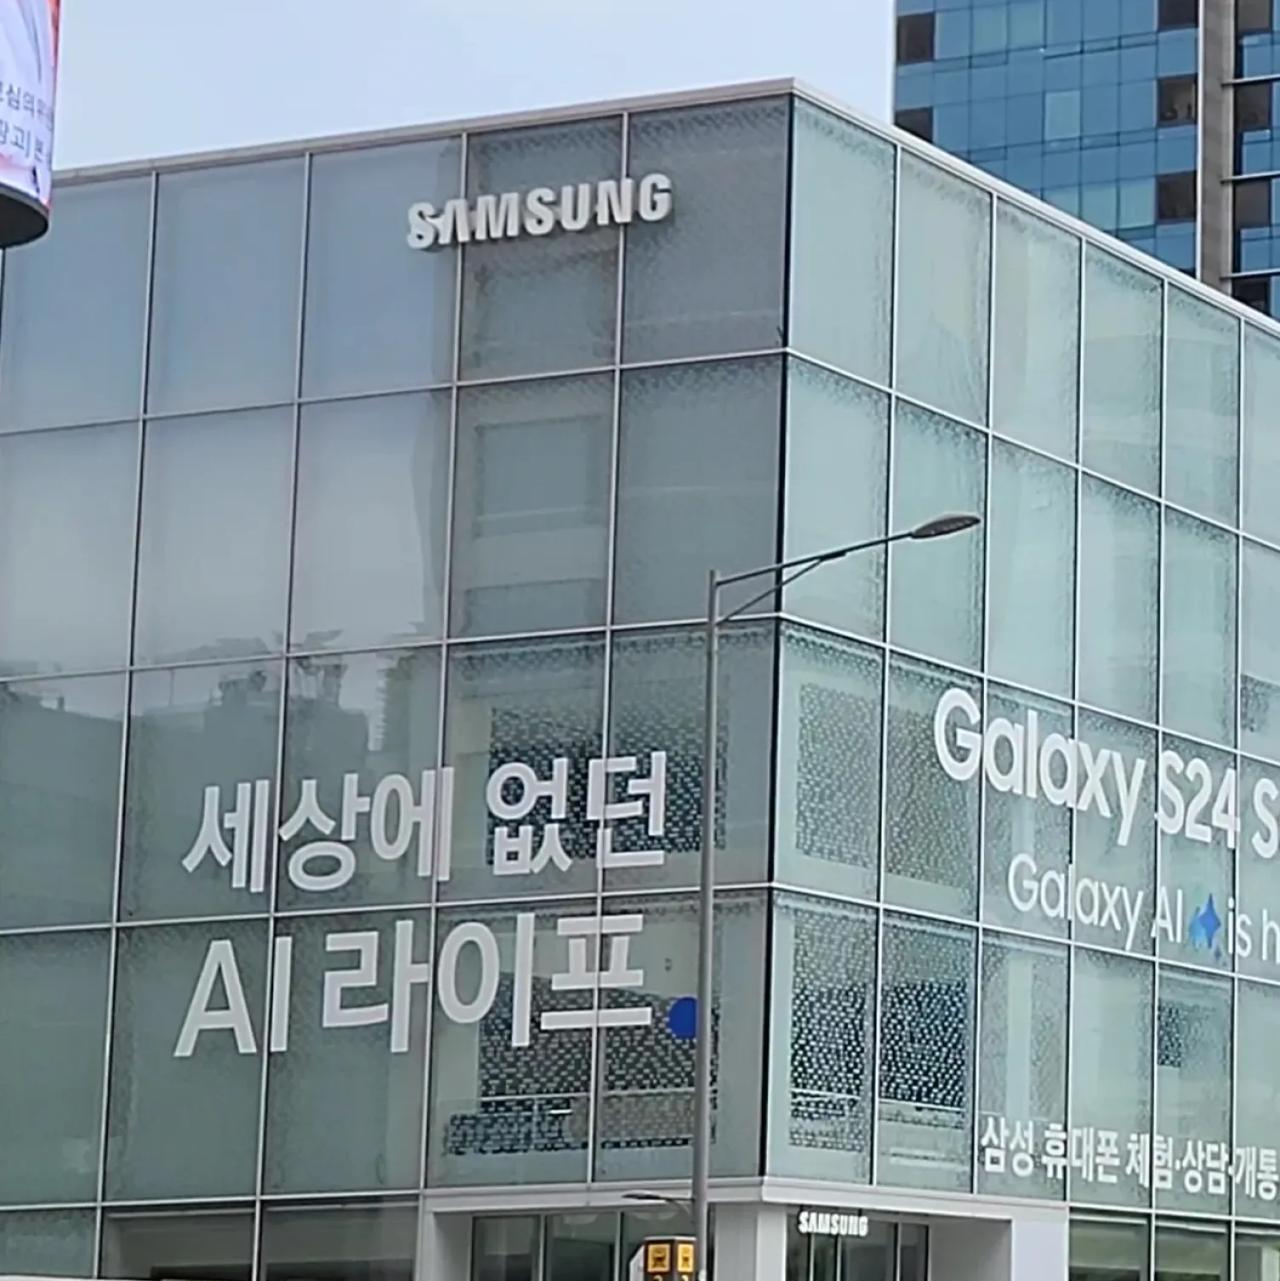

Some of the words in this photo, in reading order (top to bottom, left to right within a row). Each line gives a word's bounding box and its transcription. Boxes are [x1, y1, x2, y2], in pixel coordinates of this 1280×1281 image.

[406, 173, 673, 250] SAMSUNG
[934, 687, 1147, 847] Galaxy
[1156, 749, 1240, 850] S24
[181, 766, 455, 894] 세상에
[486, 751, 667, 876] 없던
[1007, 853, 1144, 952] Galaxy
[1151, 886, 1184, 945] AI
[1226, 898, 1253, 959] is
[174, 935, 293, 1058] AI
[321, 911, 653, 1054] 라이프
[980, 1116, 1036, 1178] 삼성
[1041, 1122, 1121, 1185] 휴대폰
[799, 1210, 869, 1238] SAMSUNG
